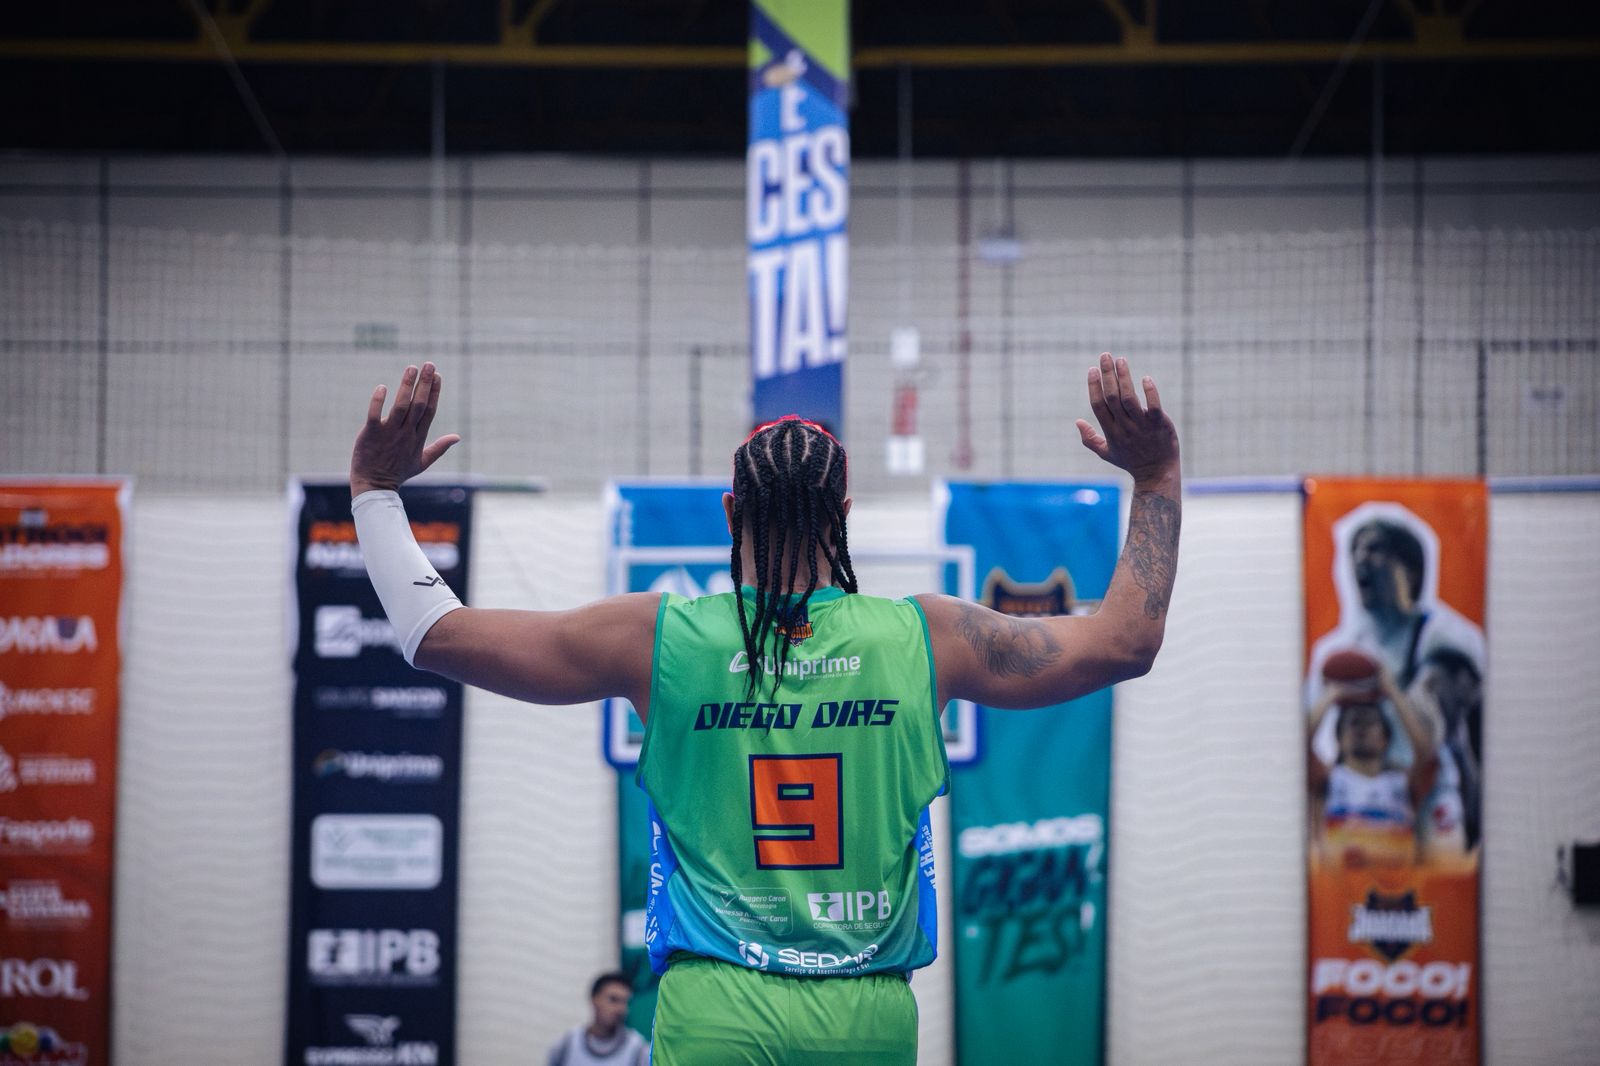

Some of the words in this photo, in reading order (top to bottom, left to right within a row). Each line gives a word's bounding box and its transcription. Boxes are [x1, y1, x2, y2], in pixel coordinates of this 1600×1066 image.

[746, 125, 850, 246] CES
[747, 233, 849, 381] TA!
[765, 655, 861, 680] Uniprime
[694, 702, 803, 731] DIEGO
[811, 700, 900, 728] DIAS
[748, 753, 844, 870] 9
[846, 890, 892, 921] IPB
[361, 928, 440, 976] IPB
[808, 967, 815, 975] de
[1309, 957, 1473, 998] FOCO!
